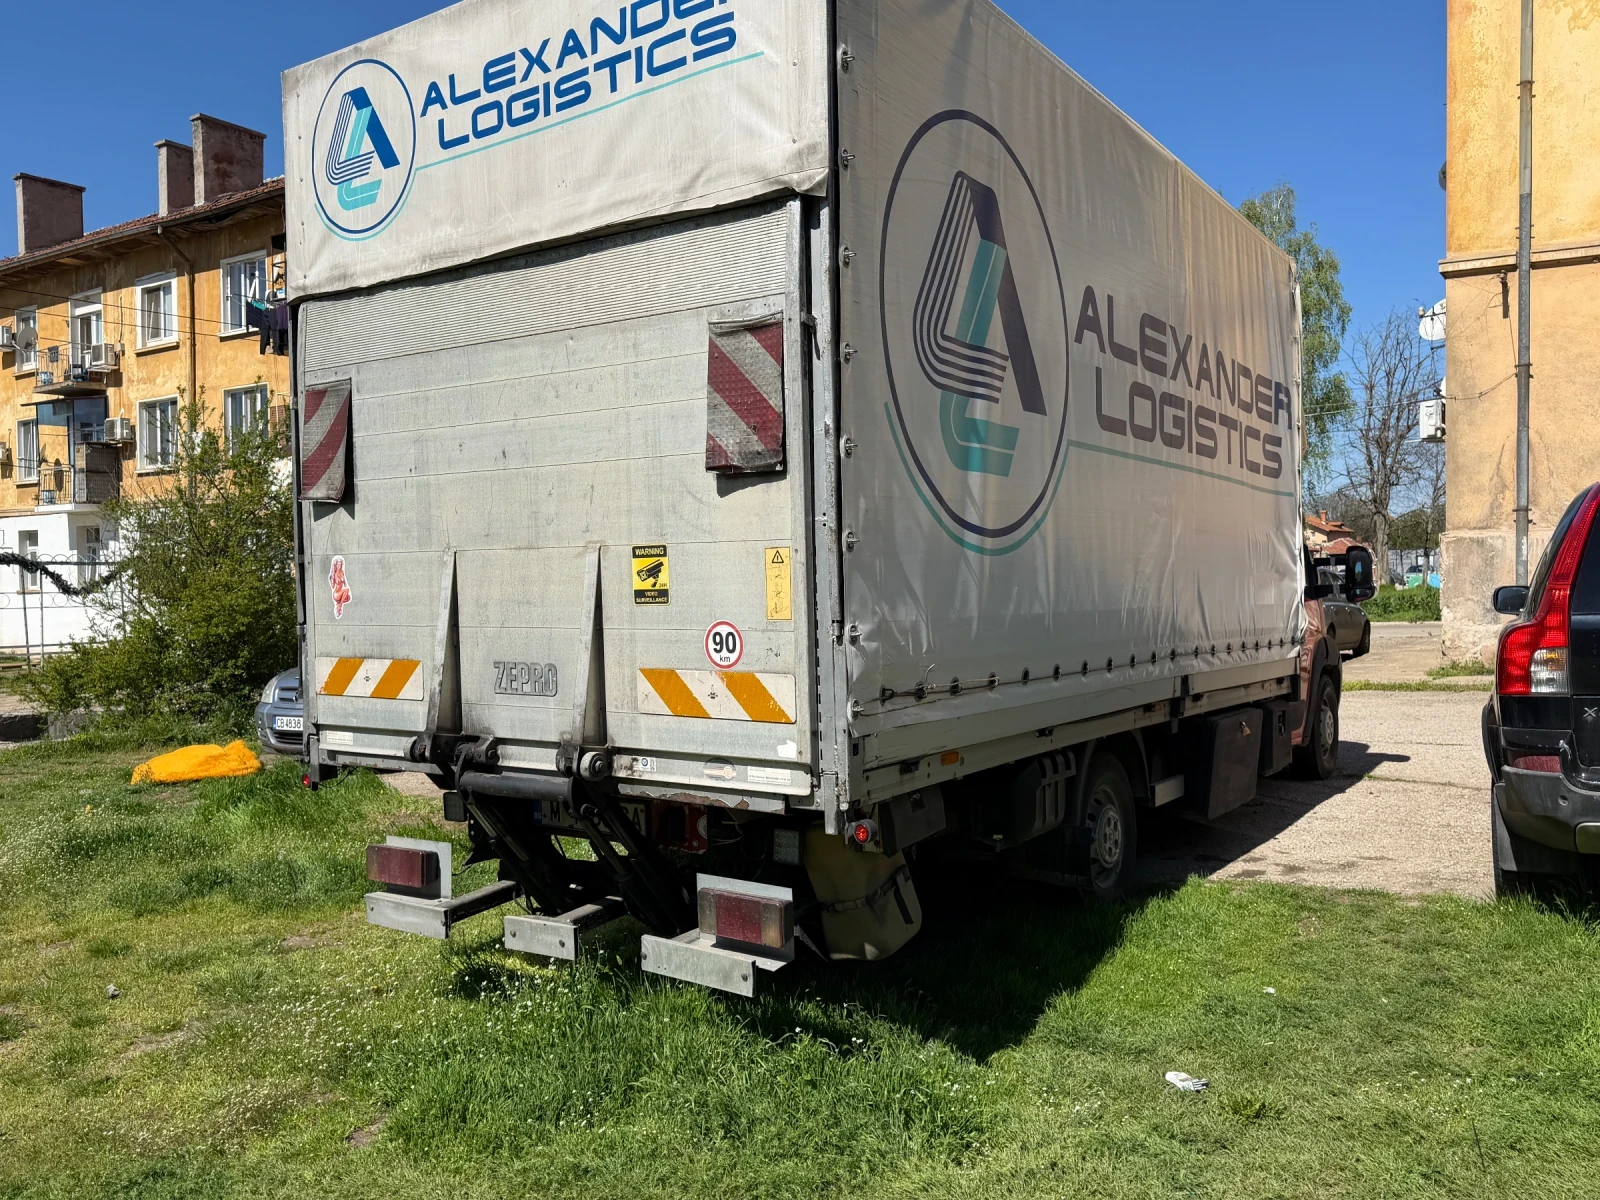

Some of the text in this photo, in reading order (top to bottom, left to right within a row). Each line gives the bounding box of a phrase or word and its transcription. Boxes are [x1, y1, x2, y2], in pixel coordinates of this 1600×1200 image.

[437, 11, 737, 150] LOGISTICS
[1074, 285, 1292, 430] ALEXANDER
[1095, 366, 1283, 479] LOGISTICS
[635, 547, 665, 556] WARNING
[712, 631, 737, 654] 90
[719, 654, 731, 662] km
[493, 661, 558, 697] ZEPRO
